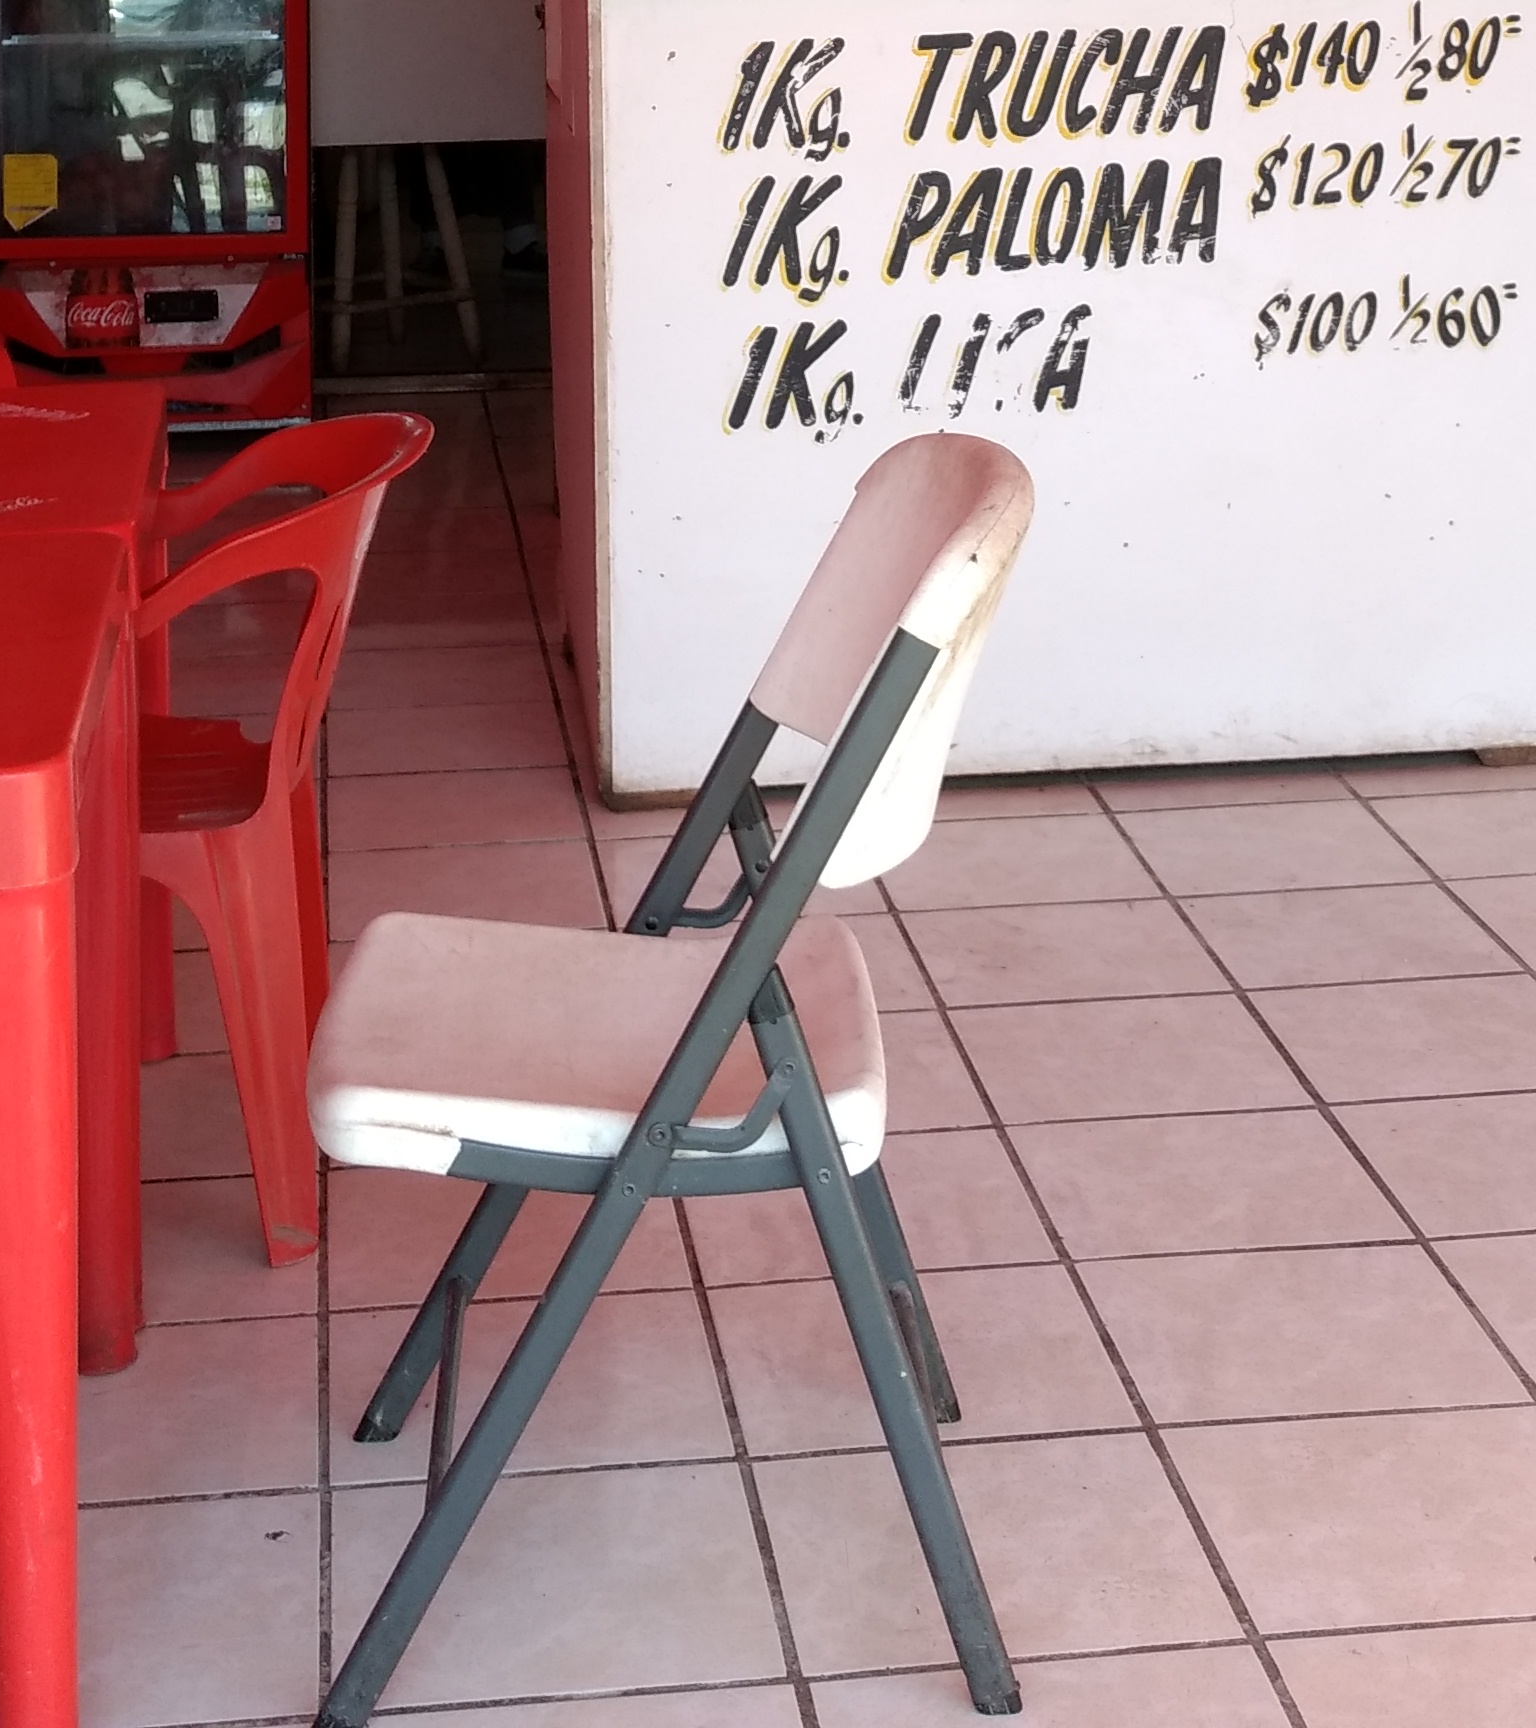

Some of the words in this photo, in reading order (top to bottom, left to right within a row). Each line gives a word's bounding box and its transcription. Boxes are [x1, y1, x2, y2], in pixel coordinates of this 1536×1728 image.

[903, 24, 1228, 148] TRUCHA
[1244, 20, 1381, 111] $140
[881, 156, 1224, 285] PALOMA
[1247, 133, 1385, 219] $120
[66, 299, 136, 328] Coca-Cola
